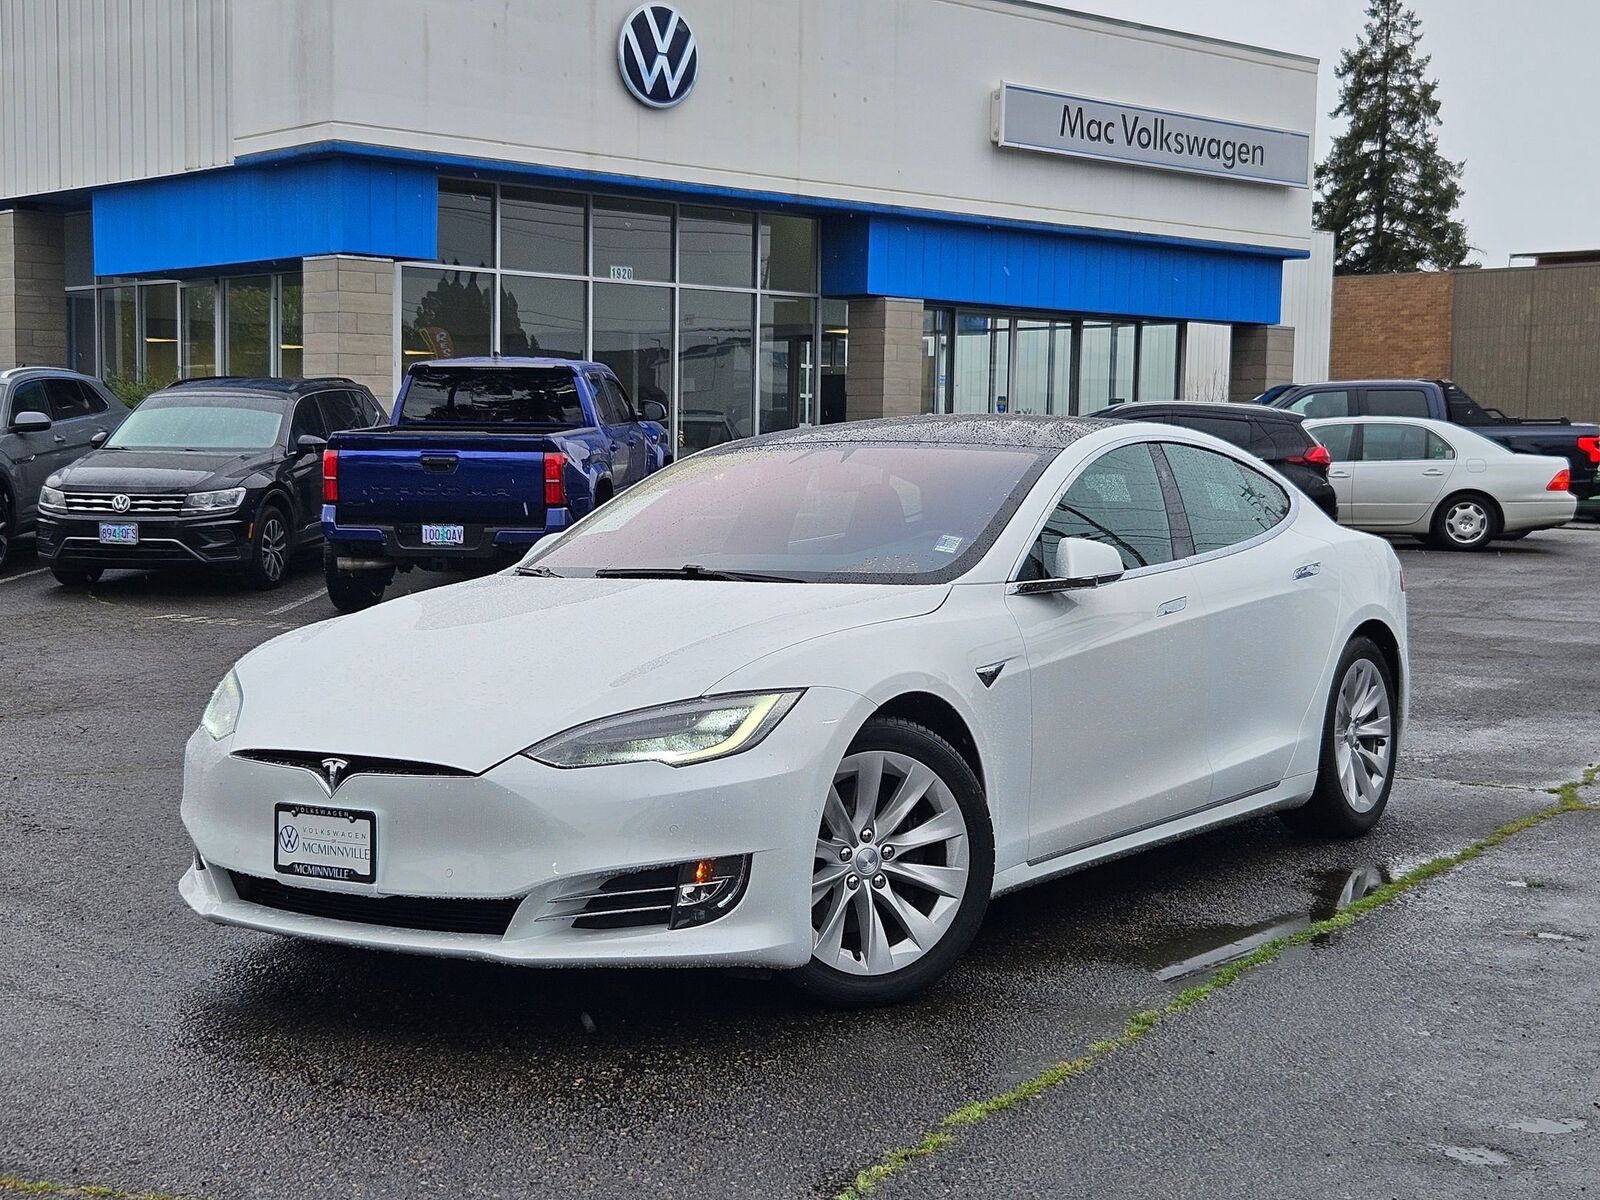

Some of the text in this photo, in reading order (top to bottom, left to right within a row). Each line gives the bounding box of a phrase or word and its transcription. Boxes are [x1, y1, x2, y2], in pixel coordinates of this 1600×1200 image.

[1059, 104, 1265, 169] Mac Volkswagen
[611, 267, 632, 280] 1920
[295, 806, 349, 818] VOLKSWAGEN
[302, 827, 367, 839] VOLKSWAGEN
[302, 842, 370, 860] MCMINNVILLE
[294, 864, 350, 880] MCMINNVILLE
